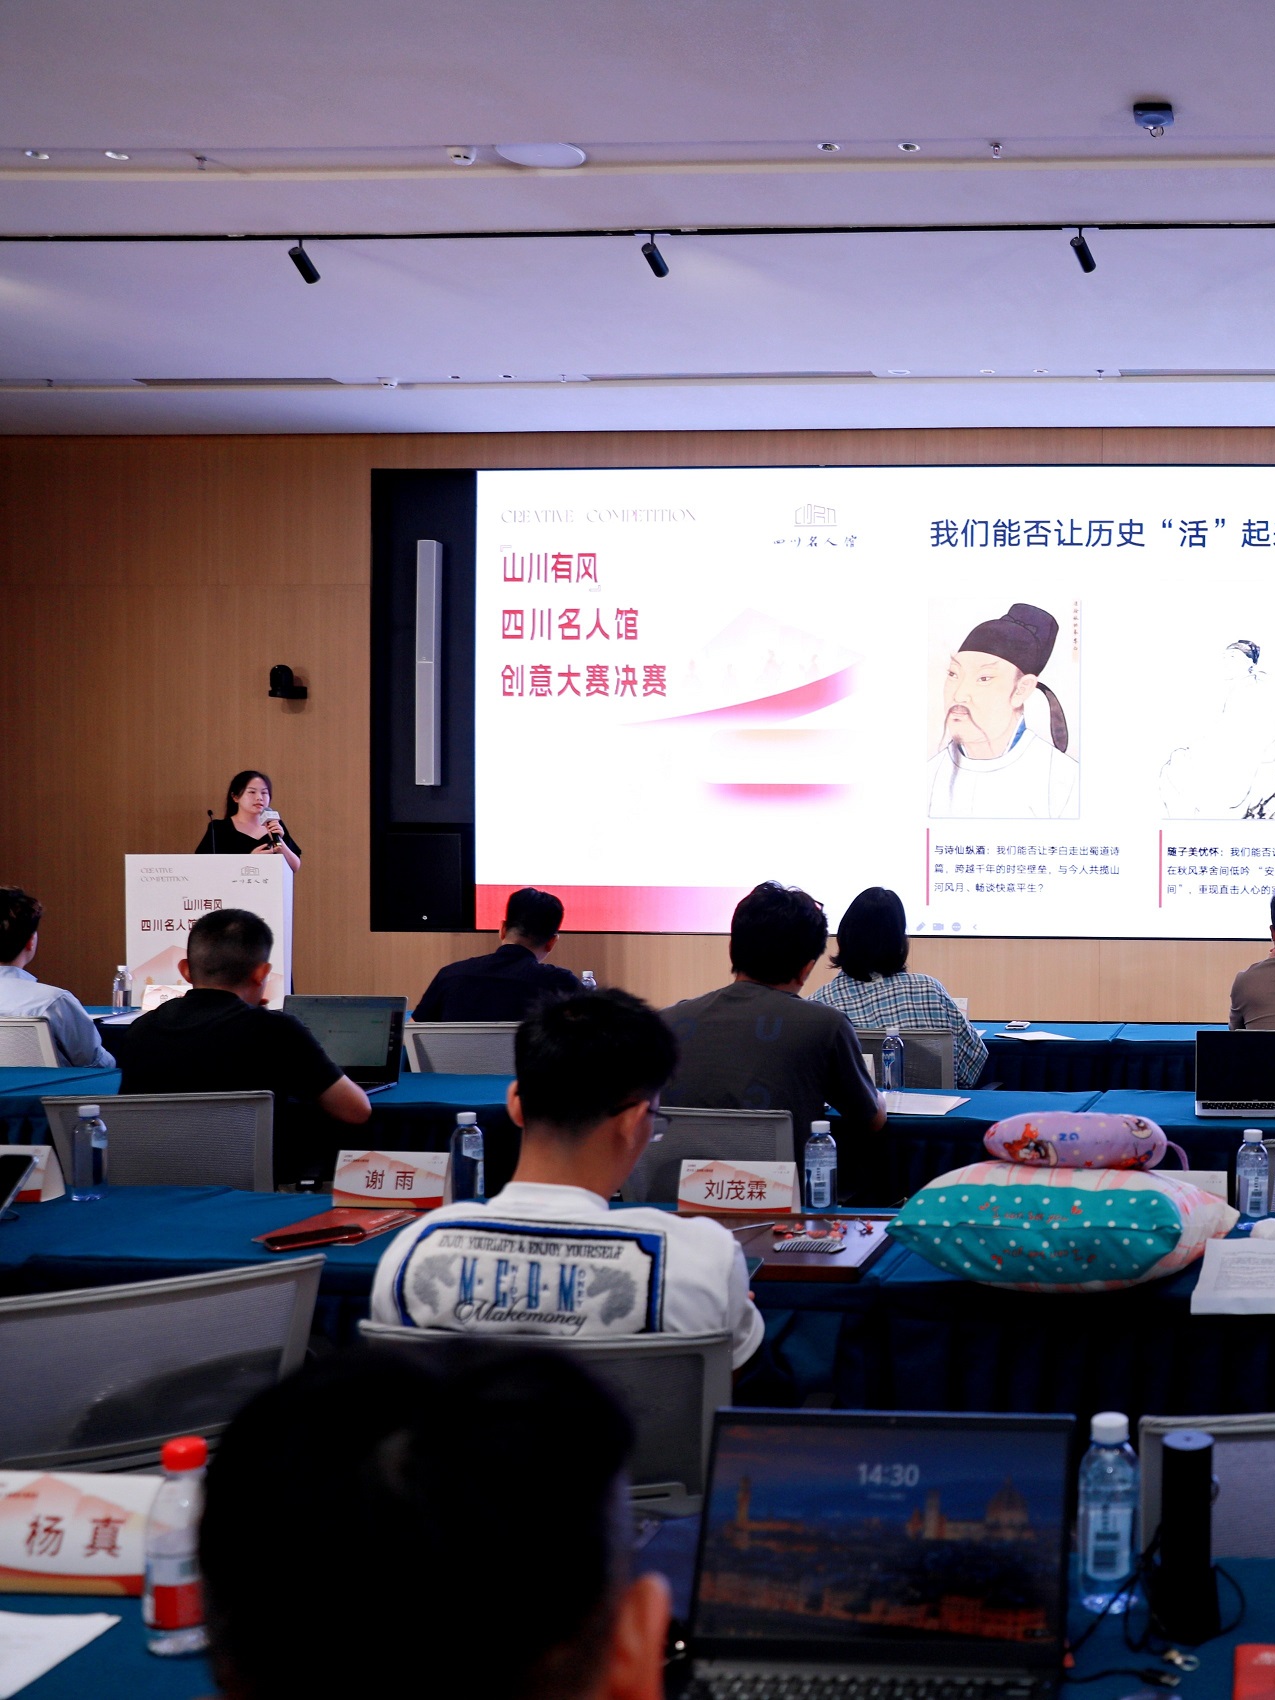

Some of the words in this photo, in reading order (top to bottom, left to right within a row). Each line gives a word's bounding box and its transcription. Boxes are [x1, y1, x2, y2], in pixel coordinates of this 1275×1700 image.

[500, 509, 574, 524] CREATIVE
[586, 508, 696, 523] COMPETITION
[773, 534, 858, 548] 四川名人馆
[501, 607, 639, 641] 四川名人馆
[501, 663, 667, 698] 创意大赛决赛
[140, 875, 189, 883] COMPETITION
[703, 1179, 768, 1202] 刘茂霖
[528, 1240, 563, 1257] ENJOY
[564, 1243, 625, 1260] YOURSELF
[857, 1462, 921, 1488] 14:30
